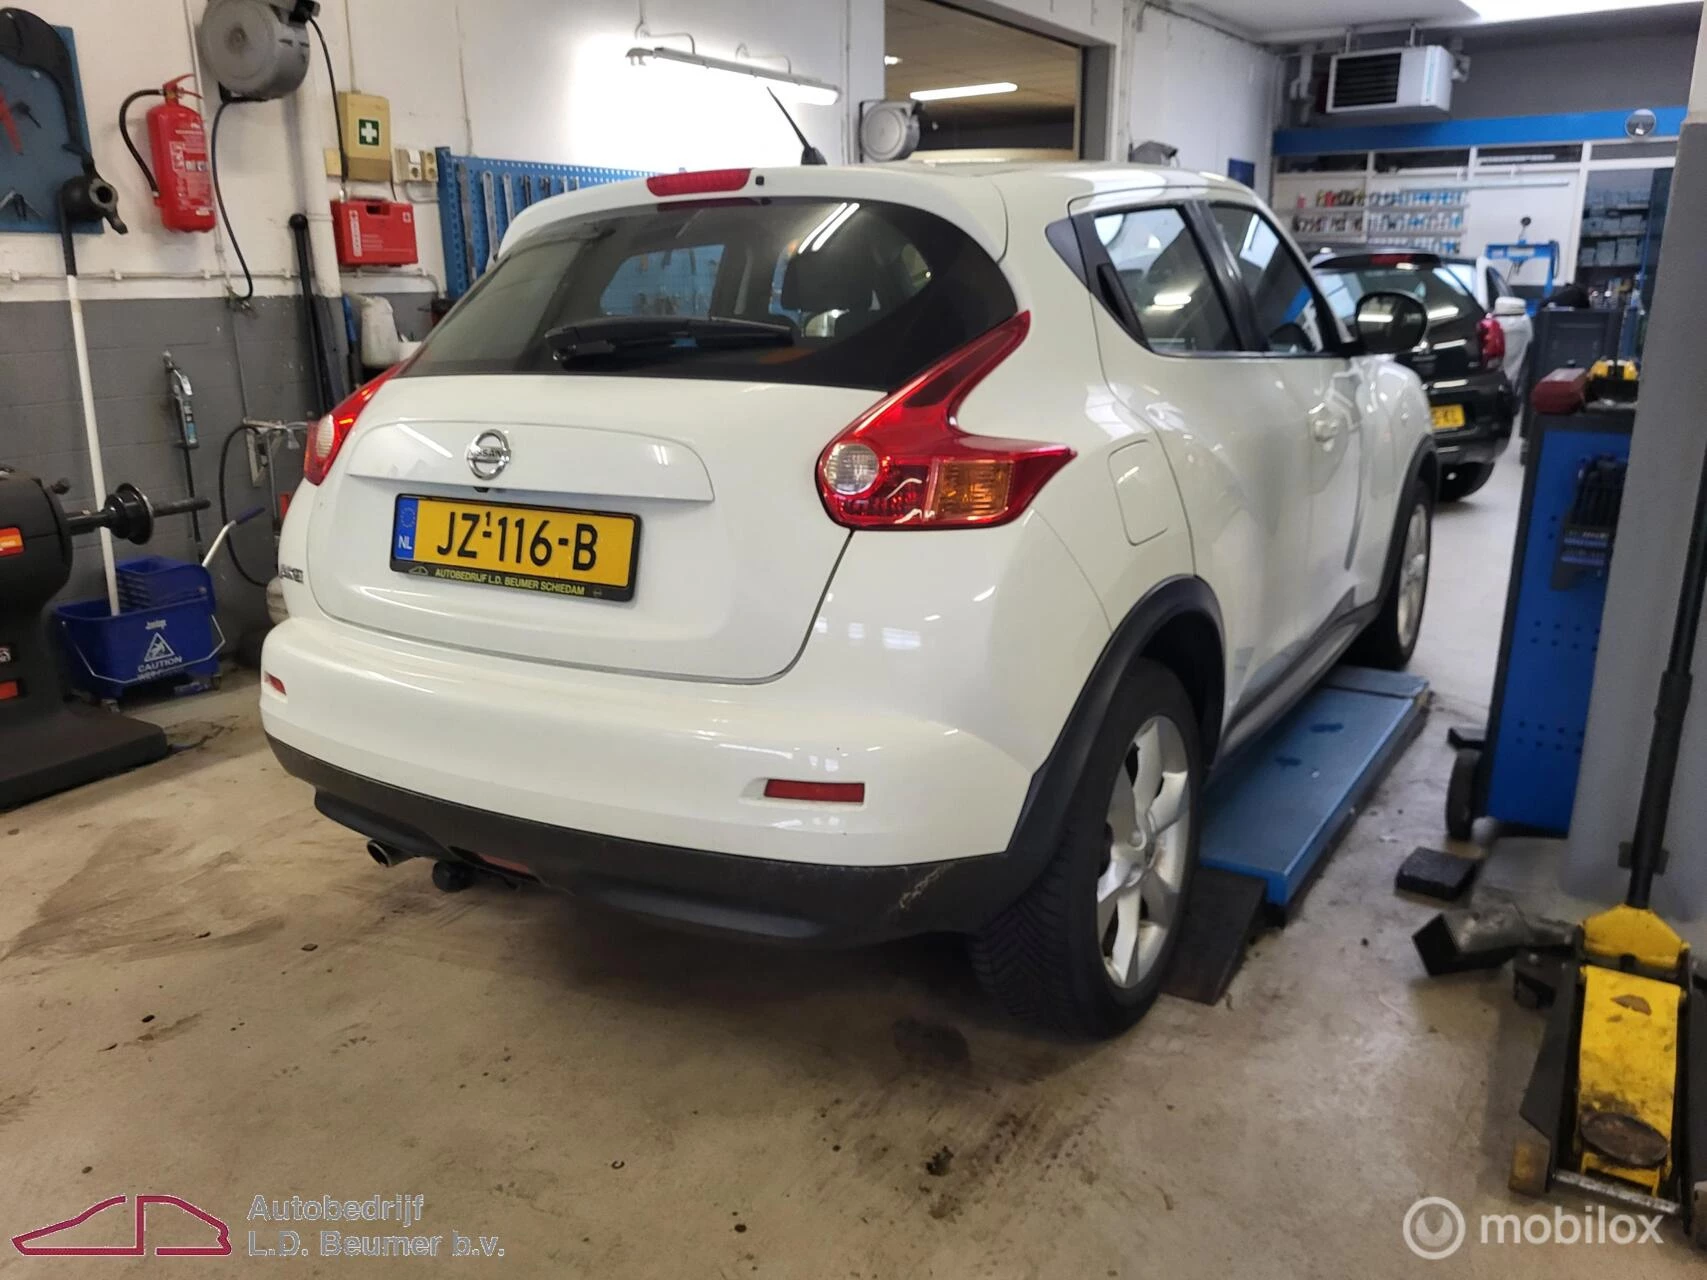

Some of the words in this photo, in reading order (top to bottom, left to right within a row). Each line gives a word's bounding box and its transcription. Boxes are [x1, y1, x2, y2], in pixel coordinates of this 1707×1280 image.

[468, 449, 505, 459] SSAN
[398, 535, 412, 550] NL
[437, 511, 598, 571] JZ-116-B
[435, 568, 487, 583] AUTOBEDRIJF
[488, 576, 503, 586] L.D.
[504, 576, 539, 588] BEUMER
[540, 581, 585, 595] SCHIEDAM
[137, 655, 183, 673] CAUTION
